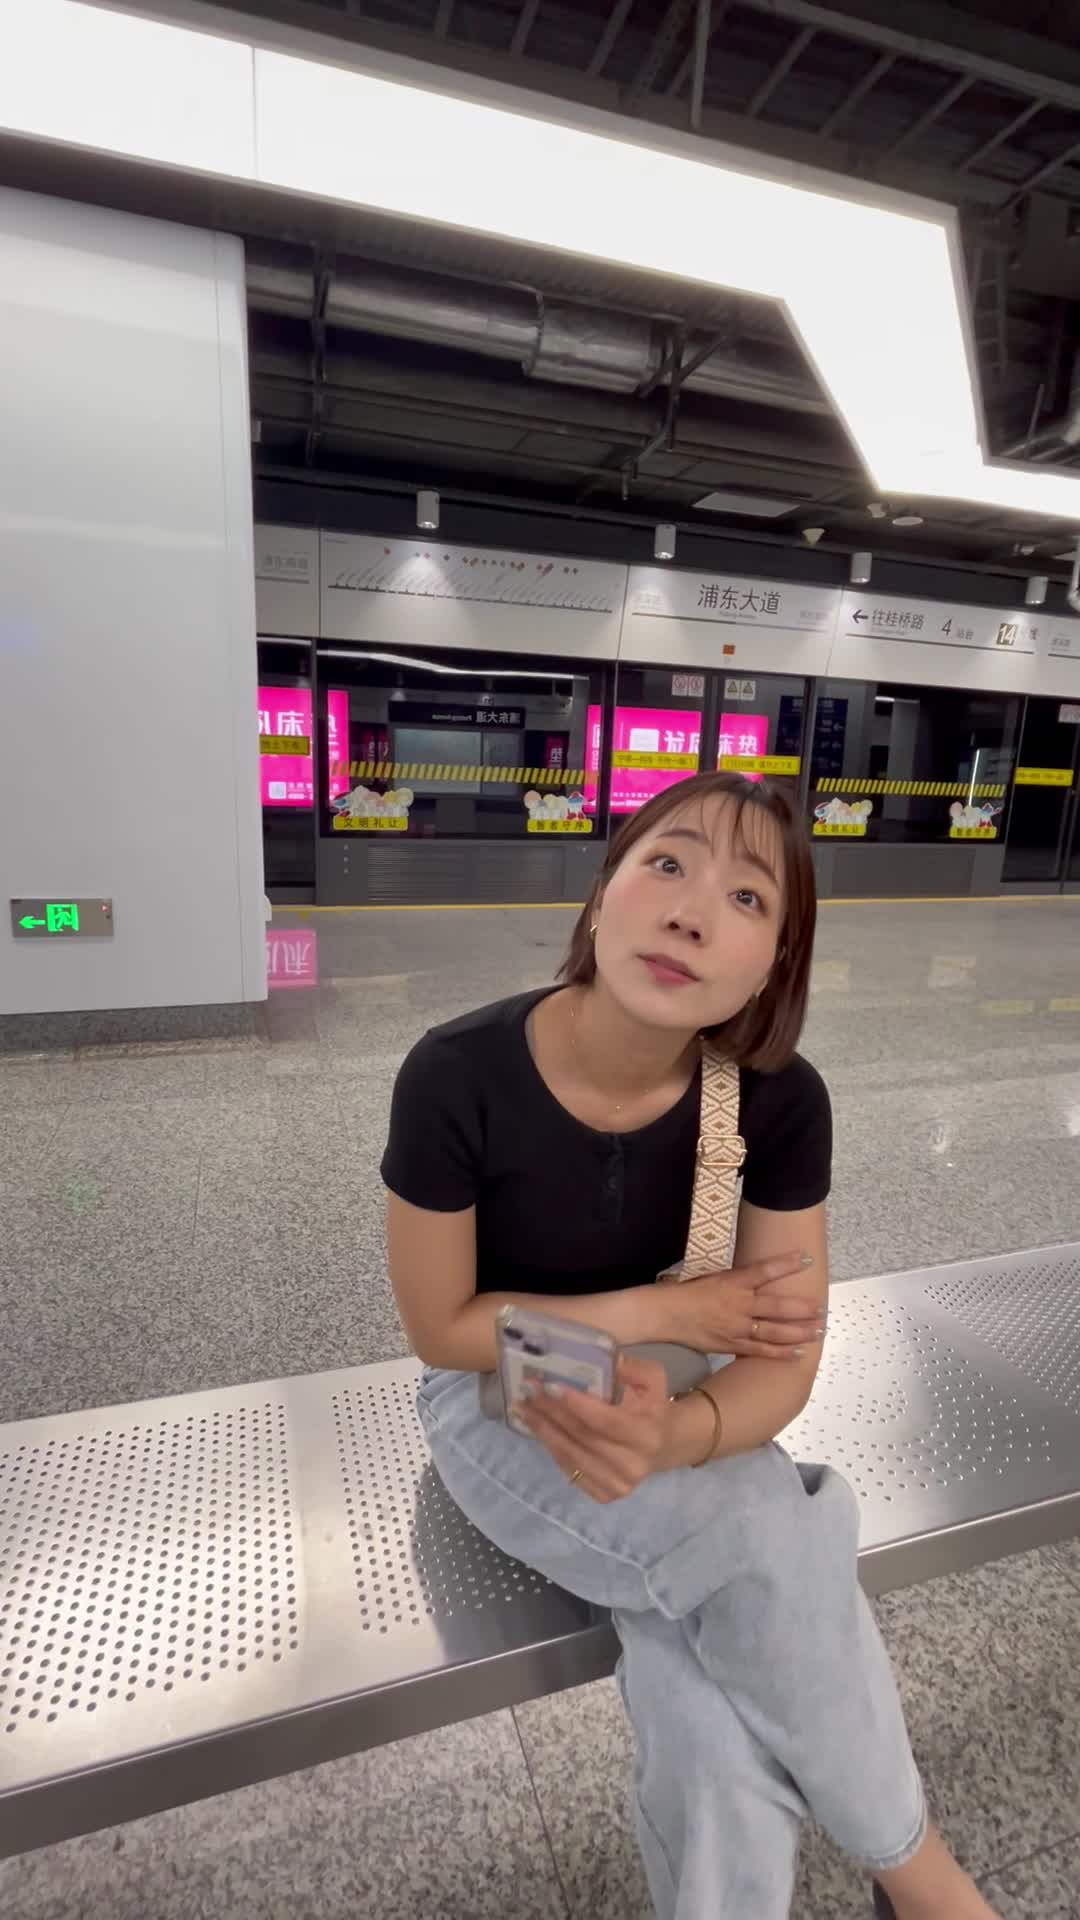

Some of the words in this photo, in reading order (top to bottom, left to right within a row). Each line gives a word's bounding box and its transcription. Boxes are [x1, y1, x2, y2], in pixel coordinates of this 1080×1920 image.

[697, 583, 782, 615] 浦东大道
[872, 608, 924, 631] 往桂桥路
[941, 618, 952, 636] 4
[1000, 624, 1017, 645] 14
